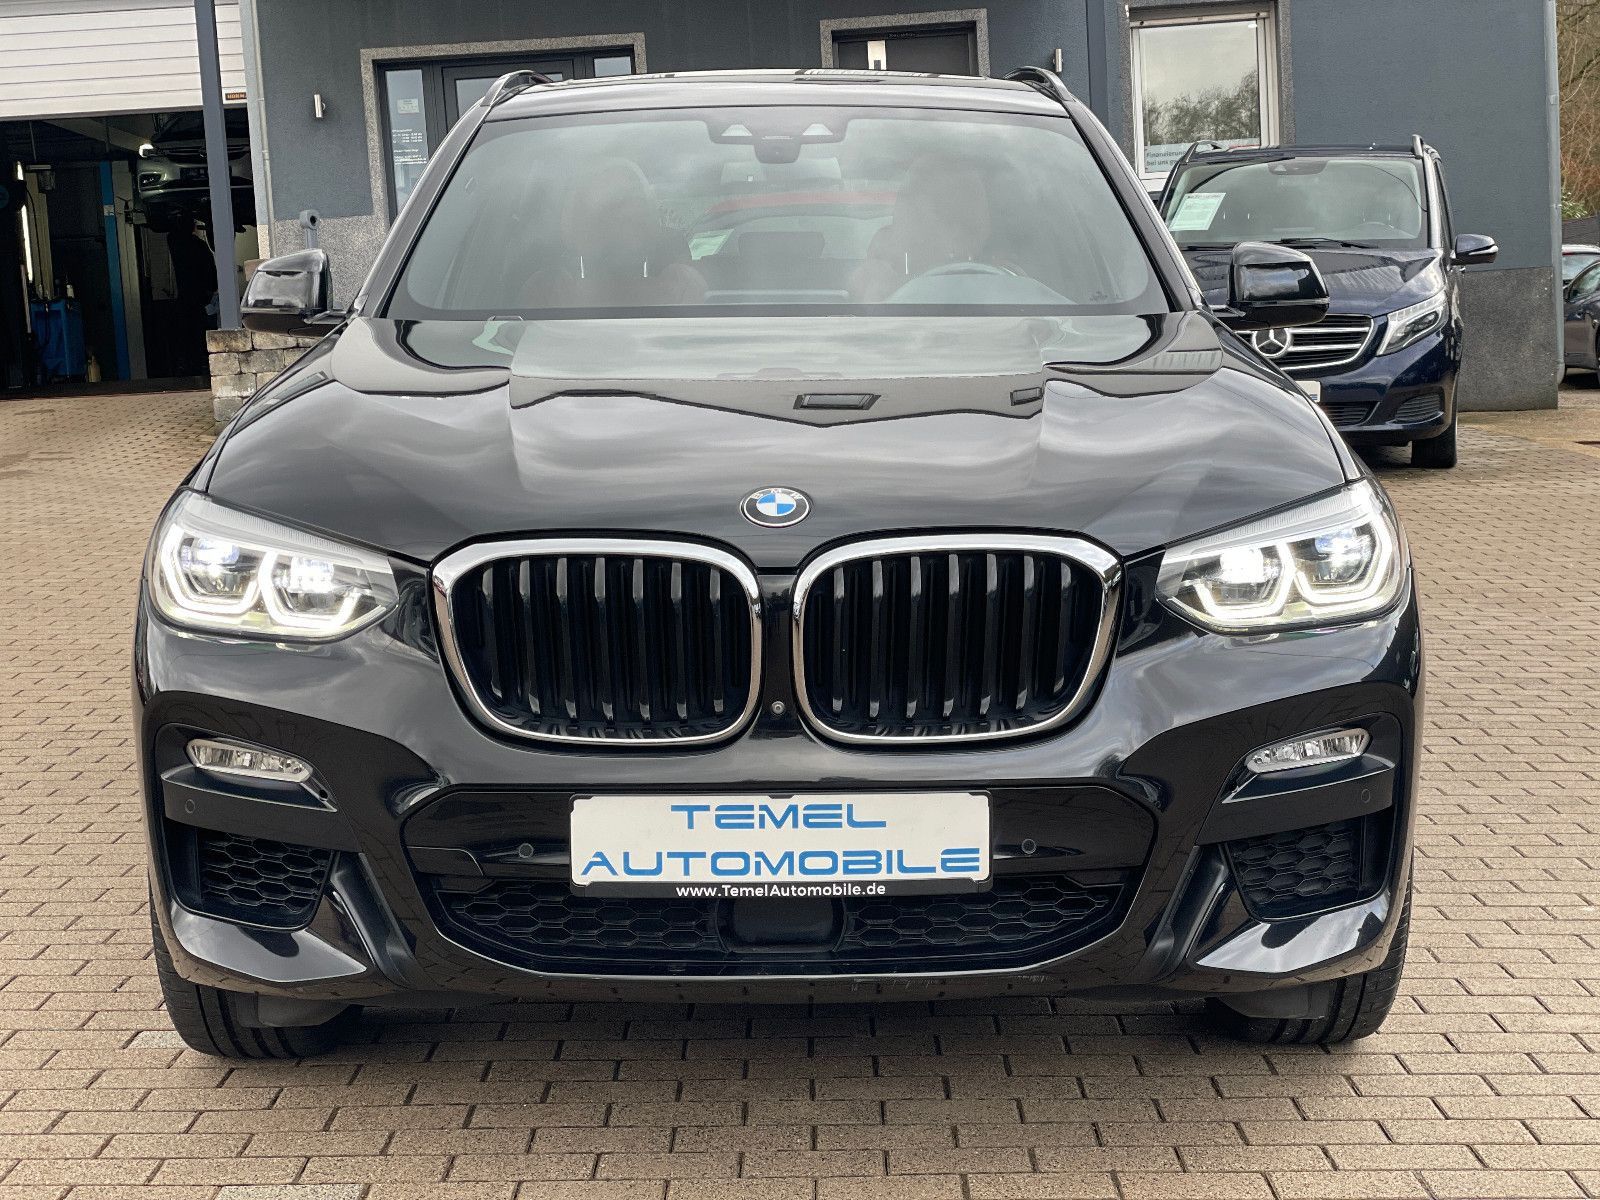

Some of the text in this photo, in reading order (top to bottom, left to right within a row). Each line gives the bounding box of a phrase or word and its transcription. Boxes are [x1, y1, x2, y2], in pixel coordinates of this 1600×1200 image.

[671, 804, 887, 829] TEMEL
[582, 848, 980, 876] AUTOMOBILE
[676, 883, 886, 897] www.TemelAutomobile.de
